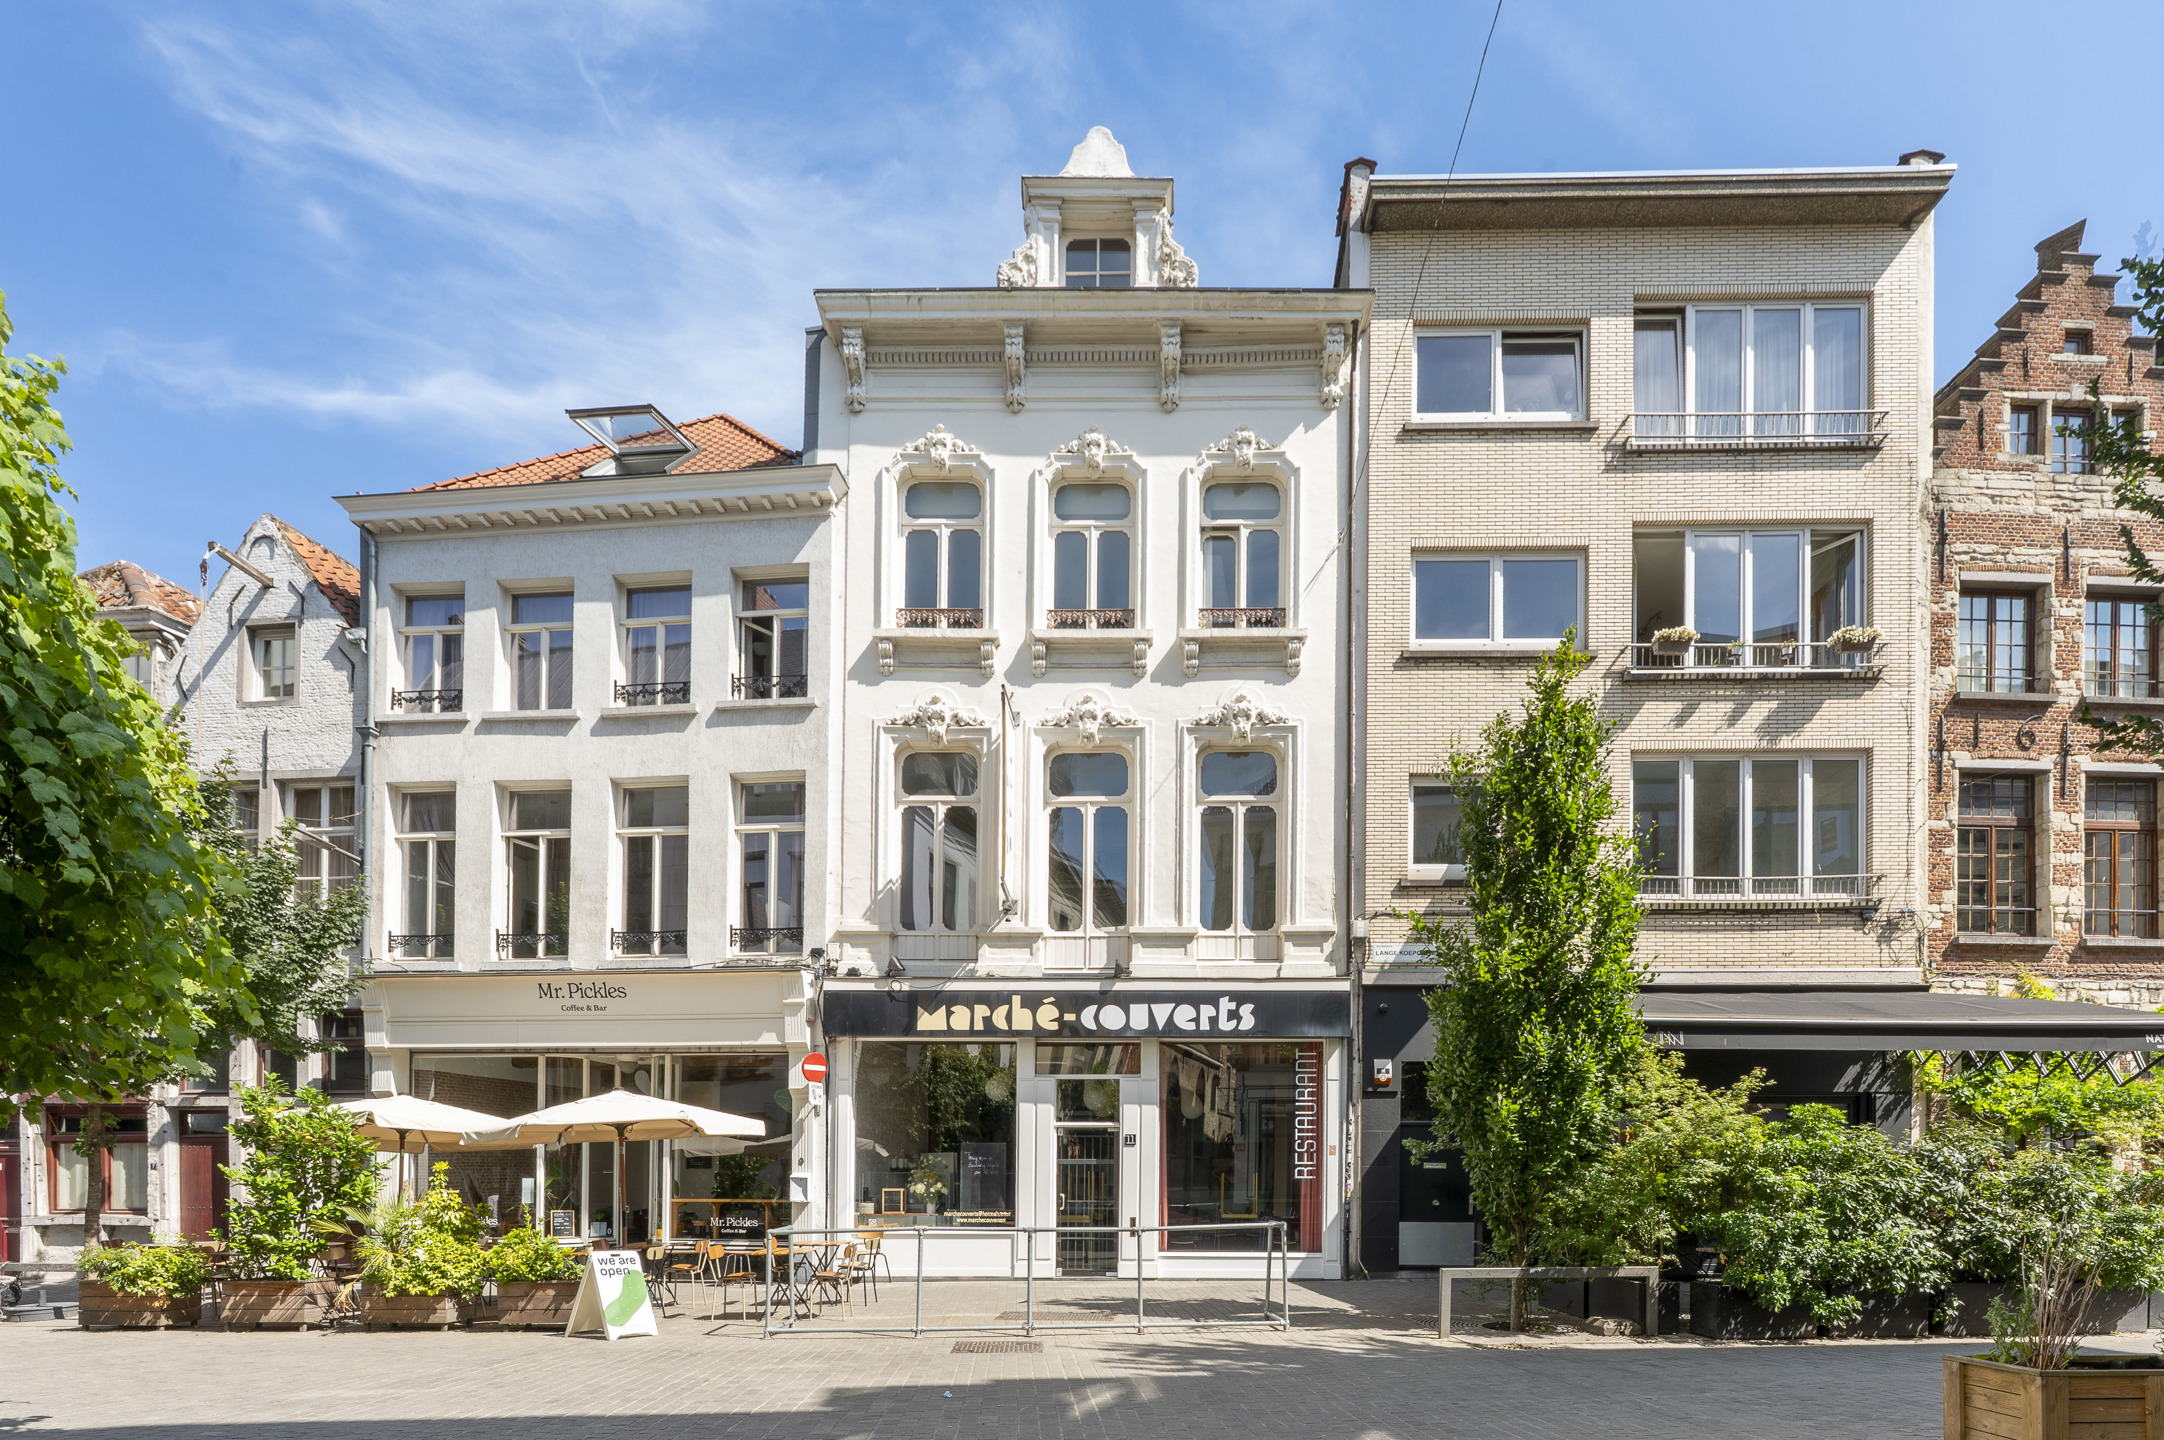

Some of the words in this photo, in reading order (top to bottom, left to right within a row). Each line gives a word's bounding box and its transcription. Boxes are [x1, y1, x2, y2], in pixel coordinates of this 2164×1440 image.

[537, 982, 565, 999] Mr.
[567, 981, 628, 999] Pickles
[561, 1004, 585, 1012] Coffee
[586, 1004, 593, 1012] &
[594, 1004, 608, 1012] Bar
[1295, 1047, 1317, 1179] RESTAURANT
[1125, 1135, 1135, 1144] 11
[710, 1217, 725, 1227] Mr.
[726, 1216, 759, 1227] Pickles
[597, 1257, 616, 1266] we
[618, 1257, 636, 1266] are
[600, 1267, 631, 1279] open
